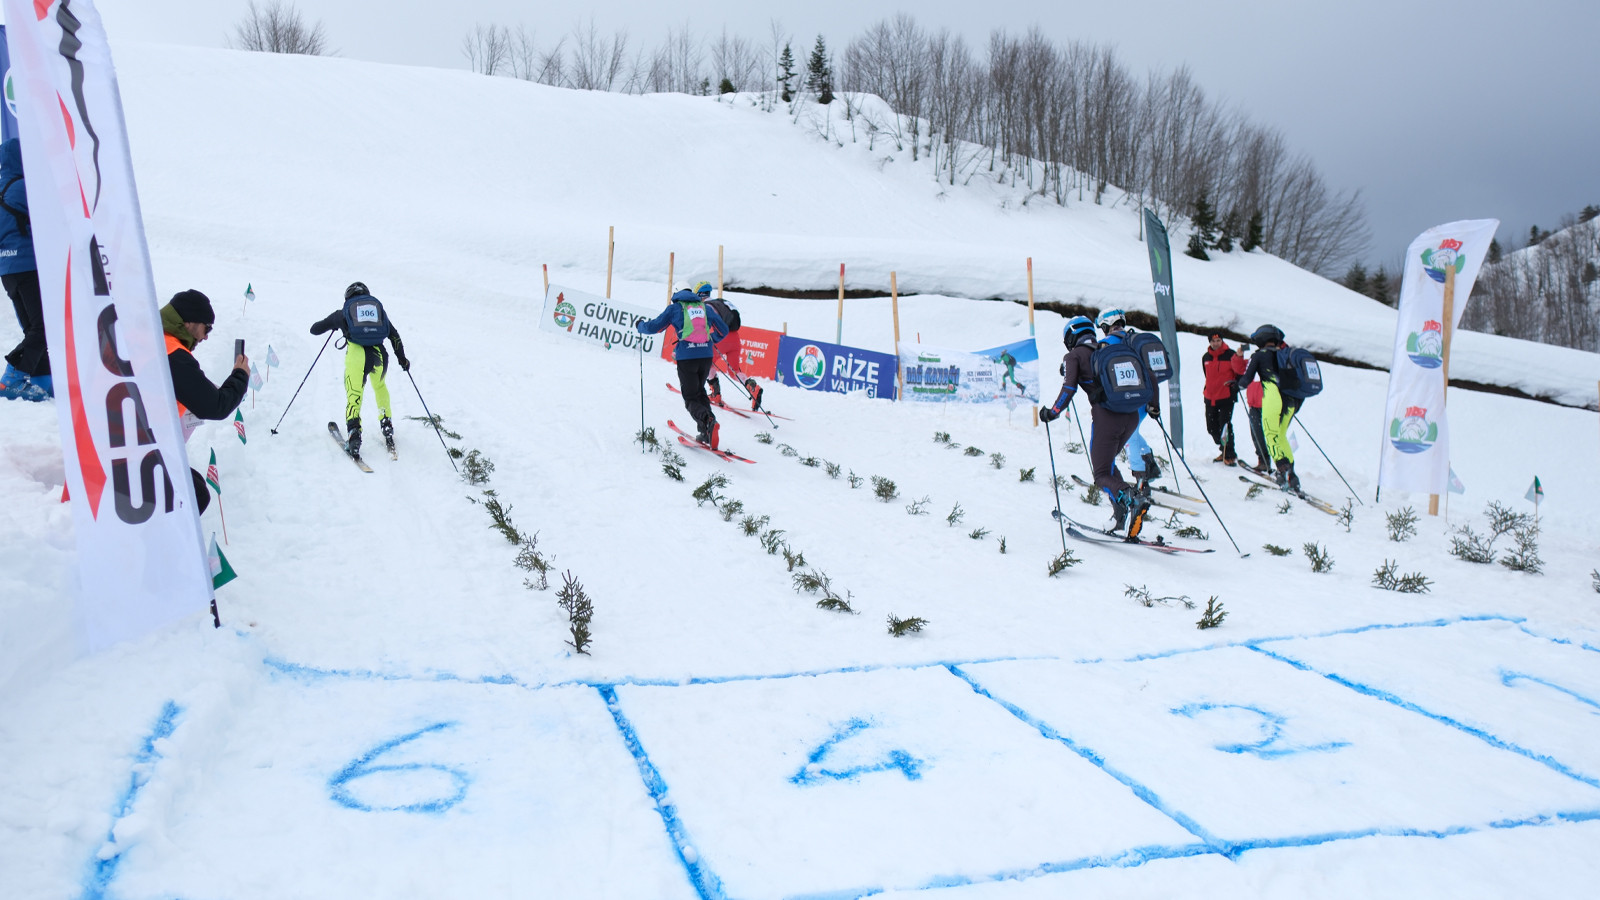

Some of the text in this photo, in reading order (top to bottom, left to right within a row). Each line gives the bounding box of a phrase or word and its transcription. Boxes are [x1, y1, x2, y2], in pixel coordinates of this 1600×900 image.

[360, 309, 375, 317] 306
[583, 302, 652, 328] GÜNEY
[577, 321, 654, 353] HANDÜZÜ
[747, 340, 768, 350] TURKEY
[745, 349, 765, 358] YOUTH
[832, 352, 880, 385] RİZE
[1119, 369, 1135, 380] 307
[1169, 701, 1354, 760] 2
[326, 721, 470, 814] 6
